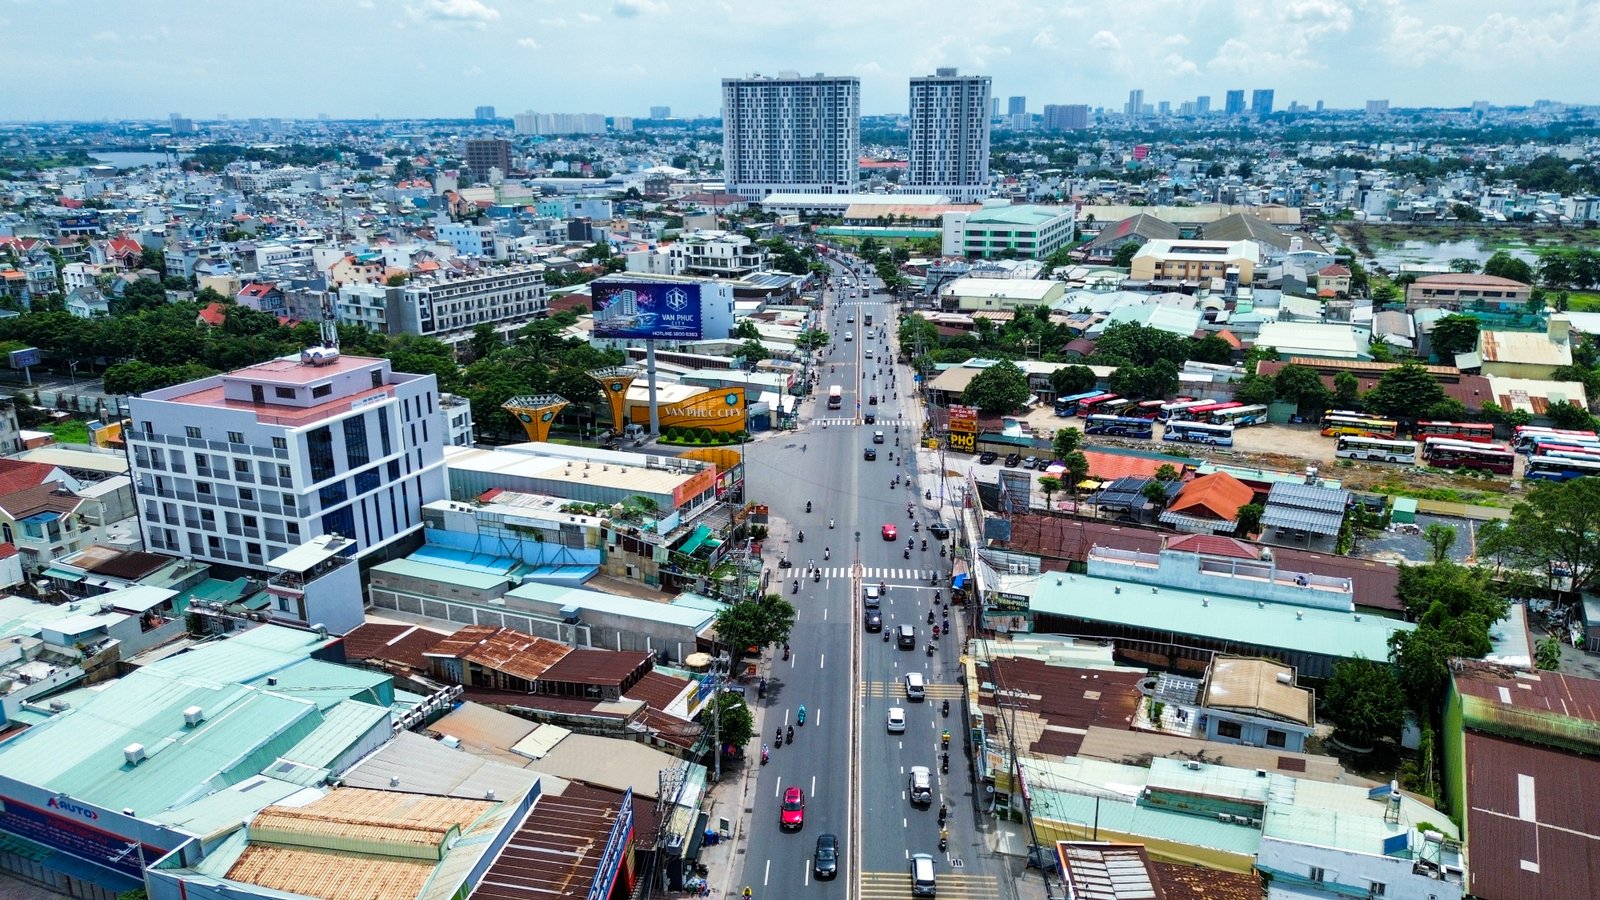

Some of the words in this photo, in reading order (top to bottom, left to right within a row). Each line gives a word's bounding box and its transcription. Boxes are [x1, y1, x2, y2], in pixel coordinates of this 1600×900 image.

[665, 407, 685, 416] VAN
[687, 408, 716, 417] PHUC
[718, 408, 742, 417] CITY
[951, 433, 974, 446] PHỞ
